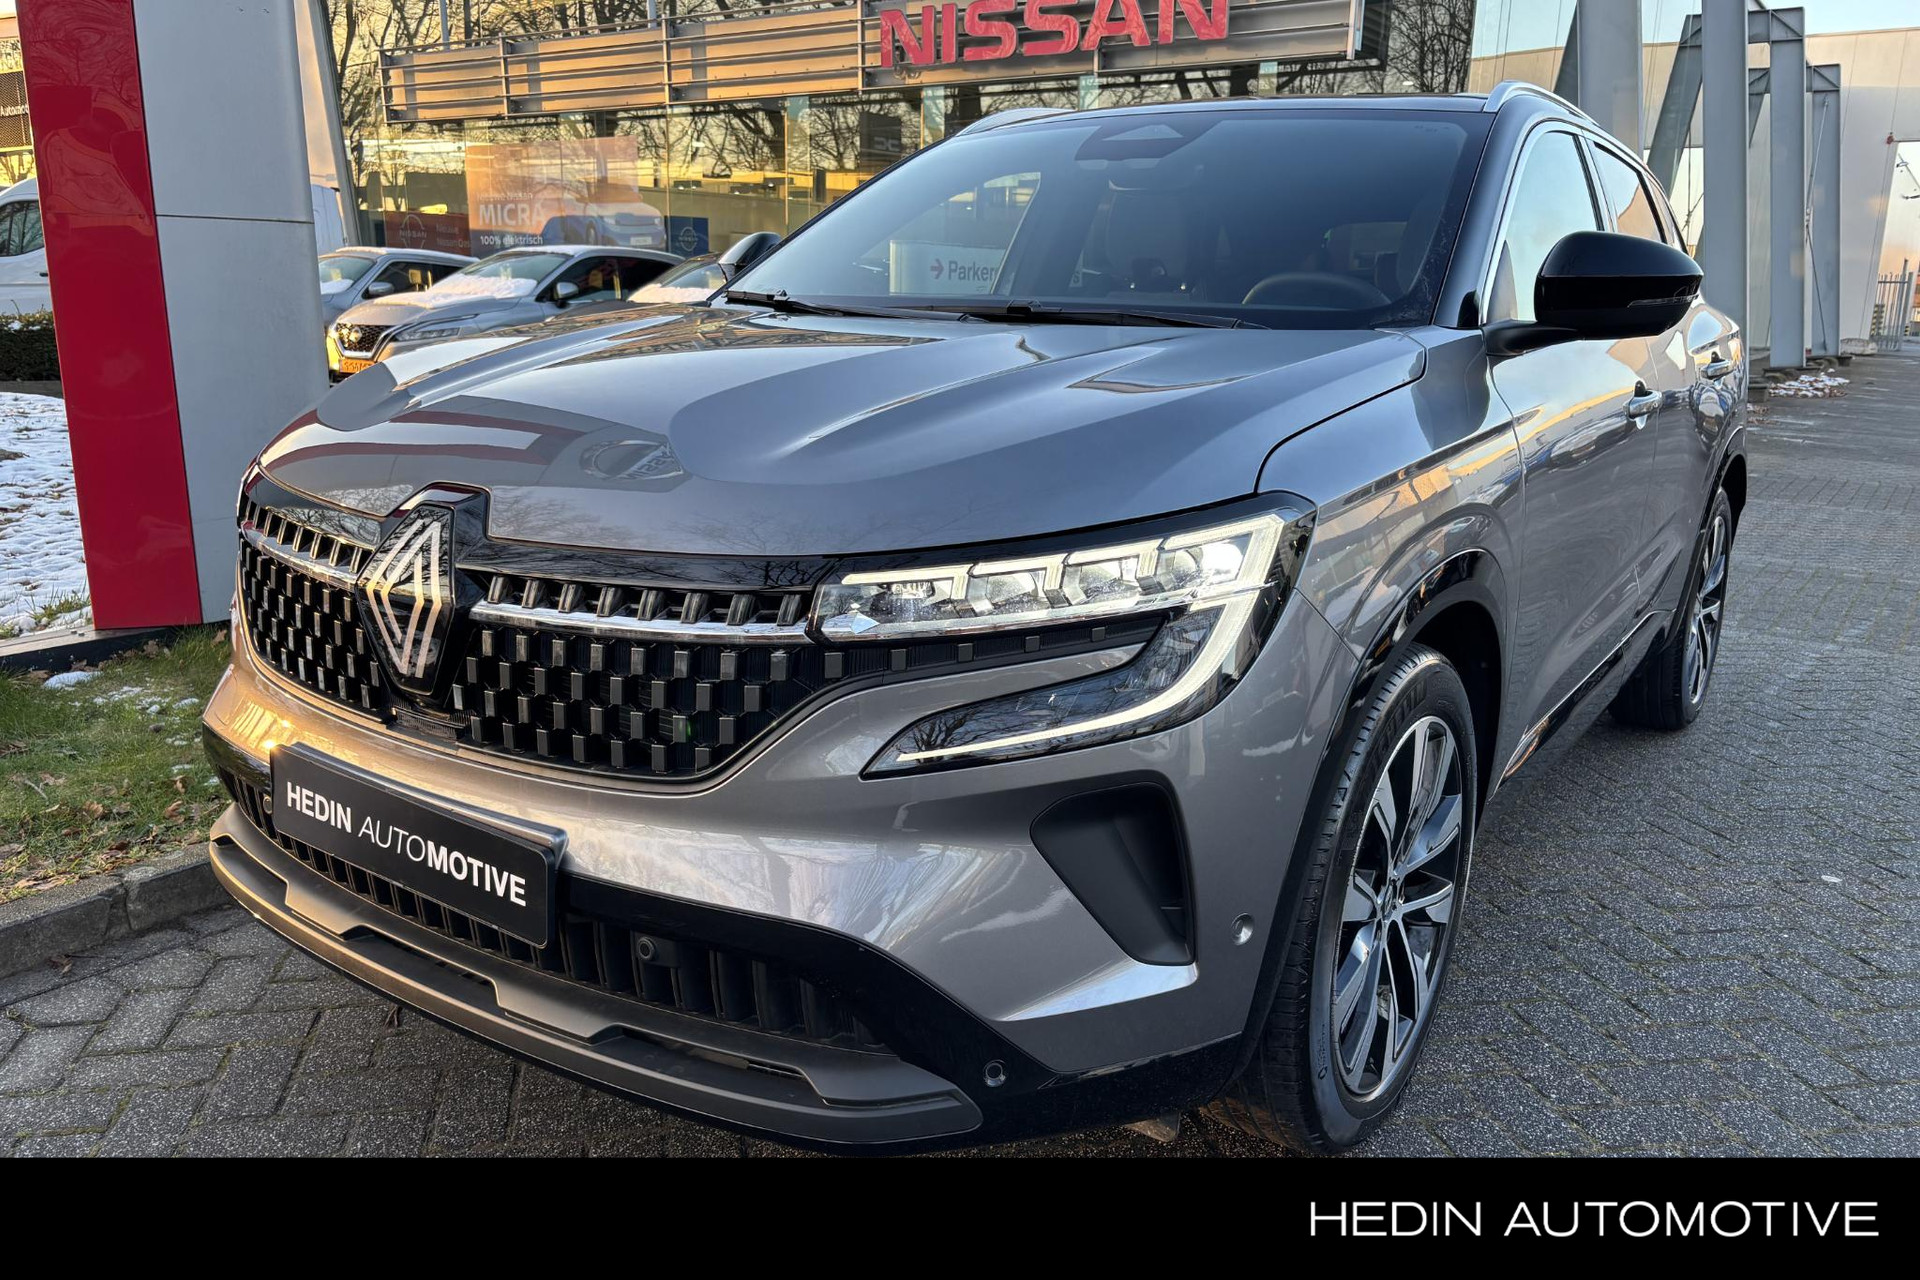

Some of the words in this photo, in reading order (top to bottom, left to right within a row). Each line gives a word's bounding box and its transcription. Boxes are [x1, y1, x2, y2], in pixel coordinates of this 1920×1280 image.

[880, 0, 1228, 67] NISSAN
[479, 203, 546, 226] MICRA
[480, 236, 500, 245] 100%
[503, 235, 543, 245] elektrisch
[287, 781, 352, 833] HEDIN
[358, 816, 526, 907] AUTOMOTIVE
